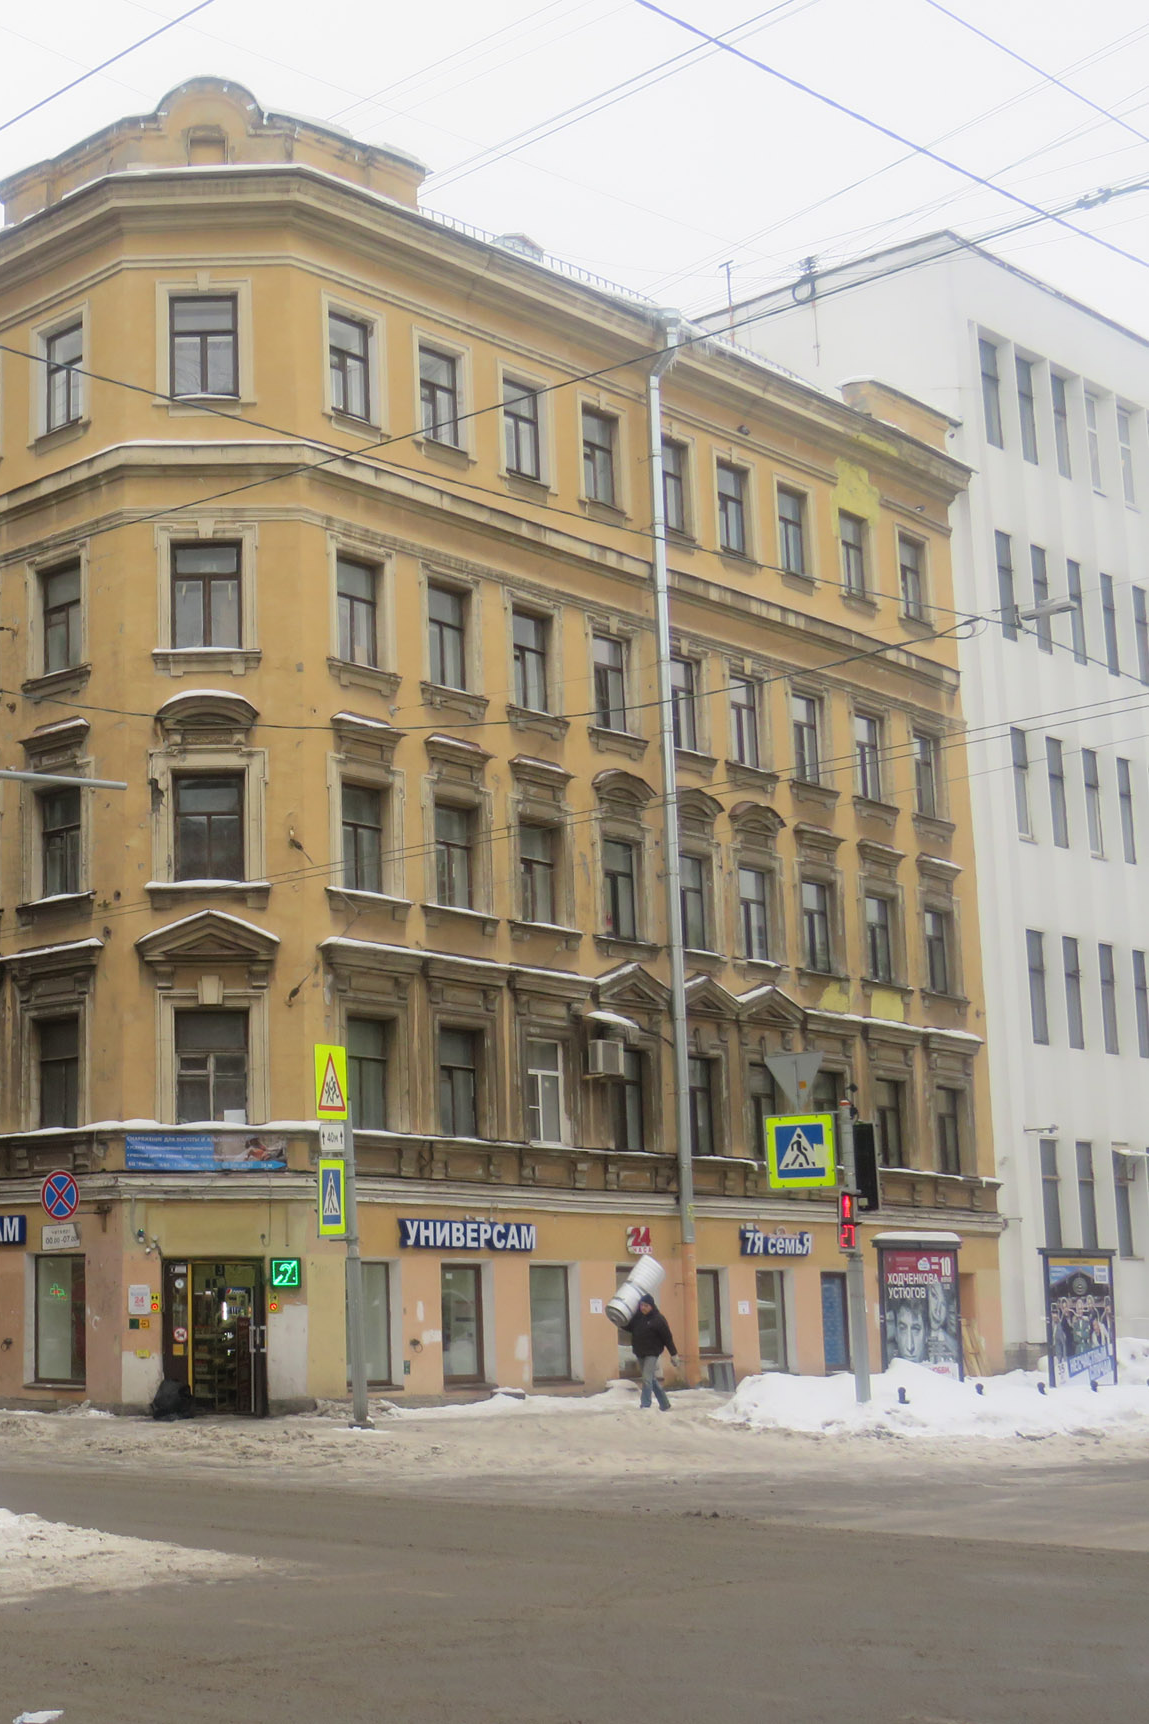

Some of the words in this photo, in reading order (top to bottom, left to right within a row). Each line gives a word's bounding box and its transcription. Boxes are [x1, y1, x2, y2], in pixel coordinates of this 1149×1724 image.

[405, 1220, 536, 1249] УНИВЕРСАМ
[628, 1227, 651, 1247] 24
[745, 1232, 763, 1254] 7Я
[768, 1234, 812, 1254] семьЯ
[840, 1224, 855, 1247] 27
[940, 1256, 951, 1276] 10
[887, 1273, 939, 1286] ХОДЧЕНКОВА
[134, 1296, 145, 1304] 24
[888, 1287, 926, 1299] УСТЮГОВ
